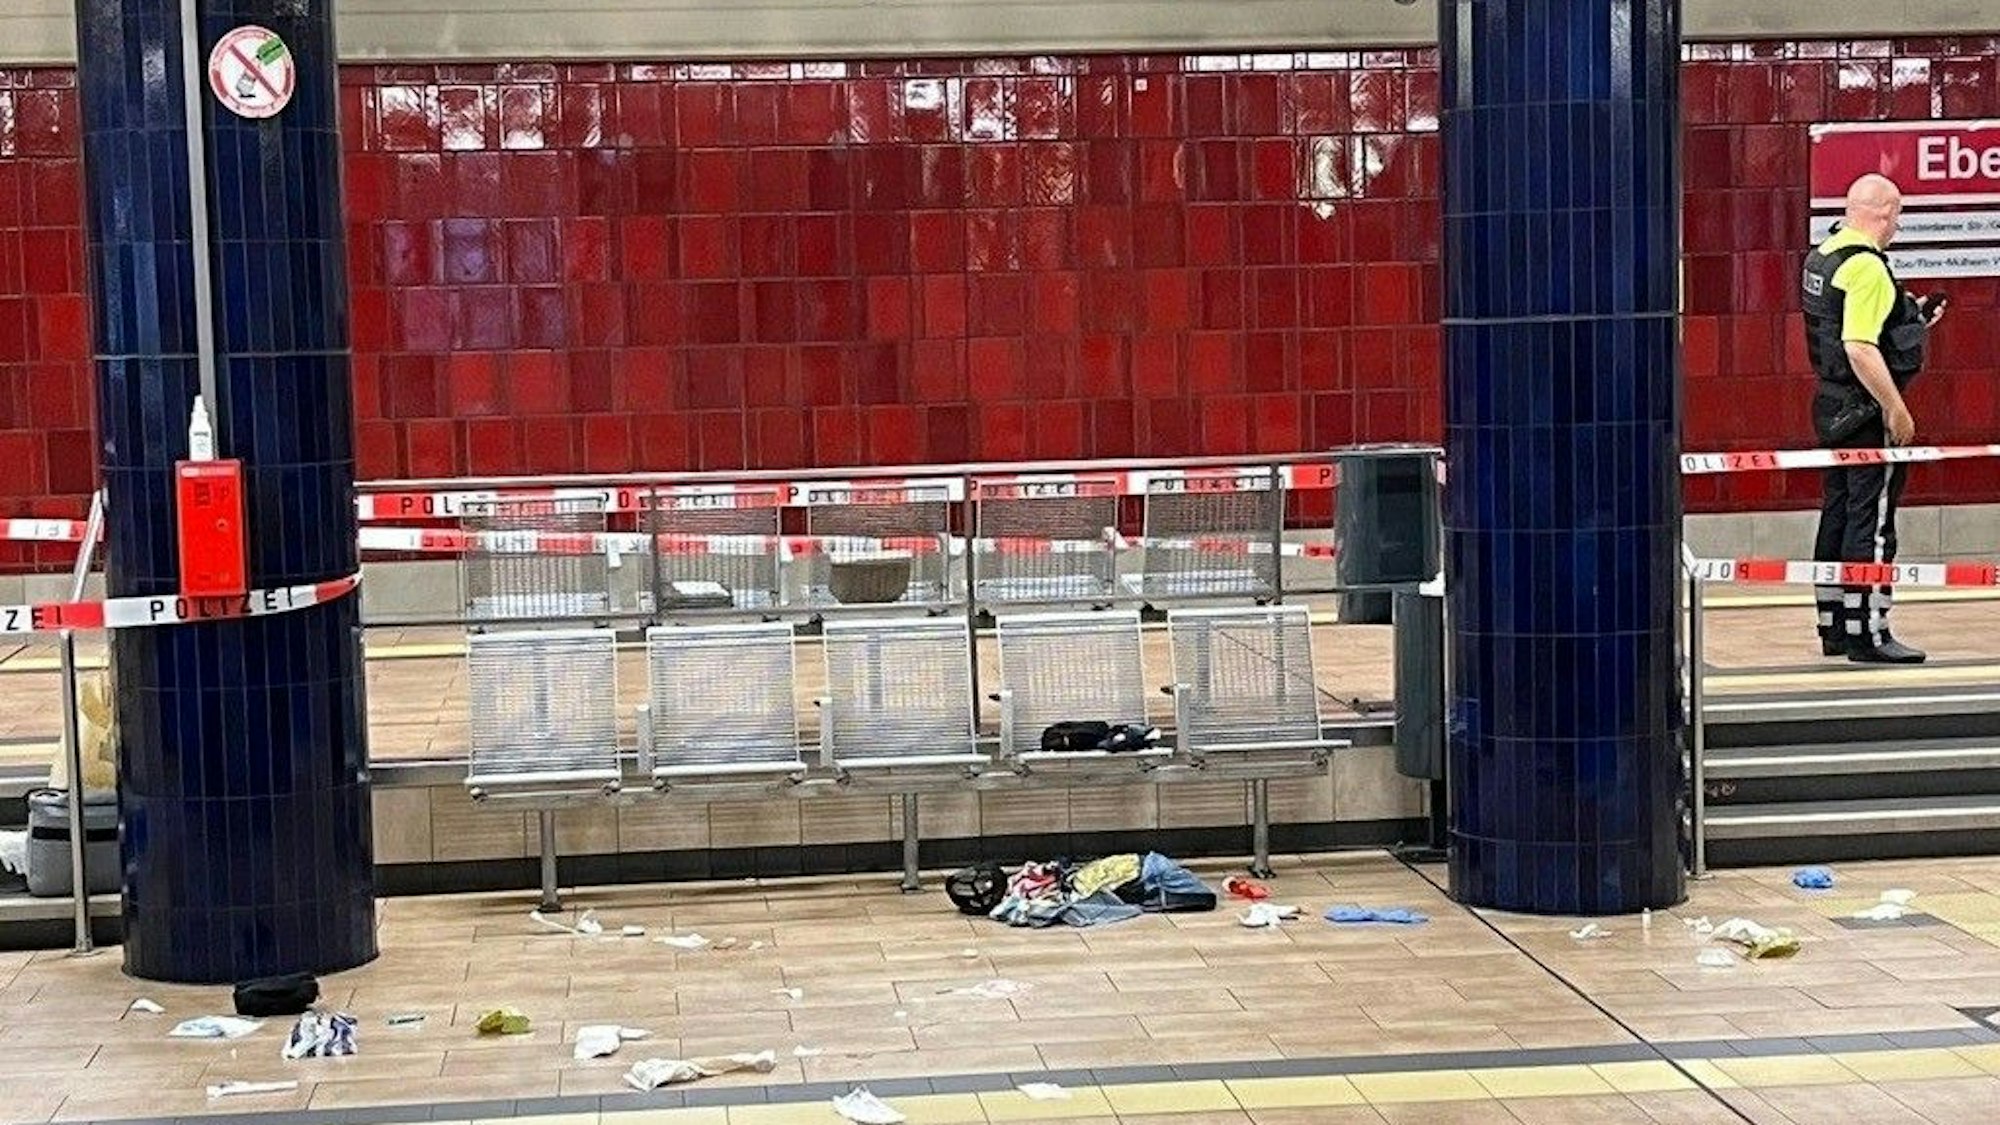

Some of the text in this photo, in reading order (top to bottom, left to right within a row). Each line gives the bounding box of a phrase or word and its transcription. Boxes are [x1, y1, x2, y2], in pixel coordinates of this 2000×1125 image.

[1918, 135, 2000, 180] Ebe
[5, 586, 296, 631] ZEI POLIZEI
